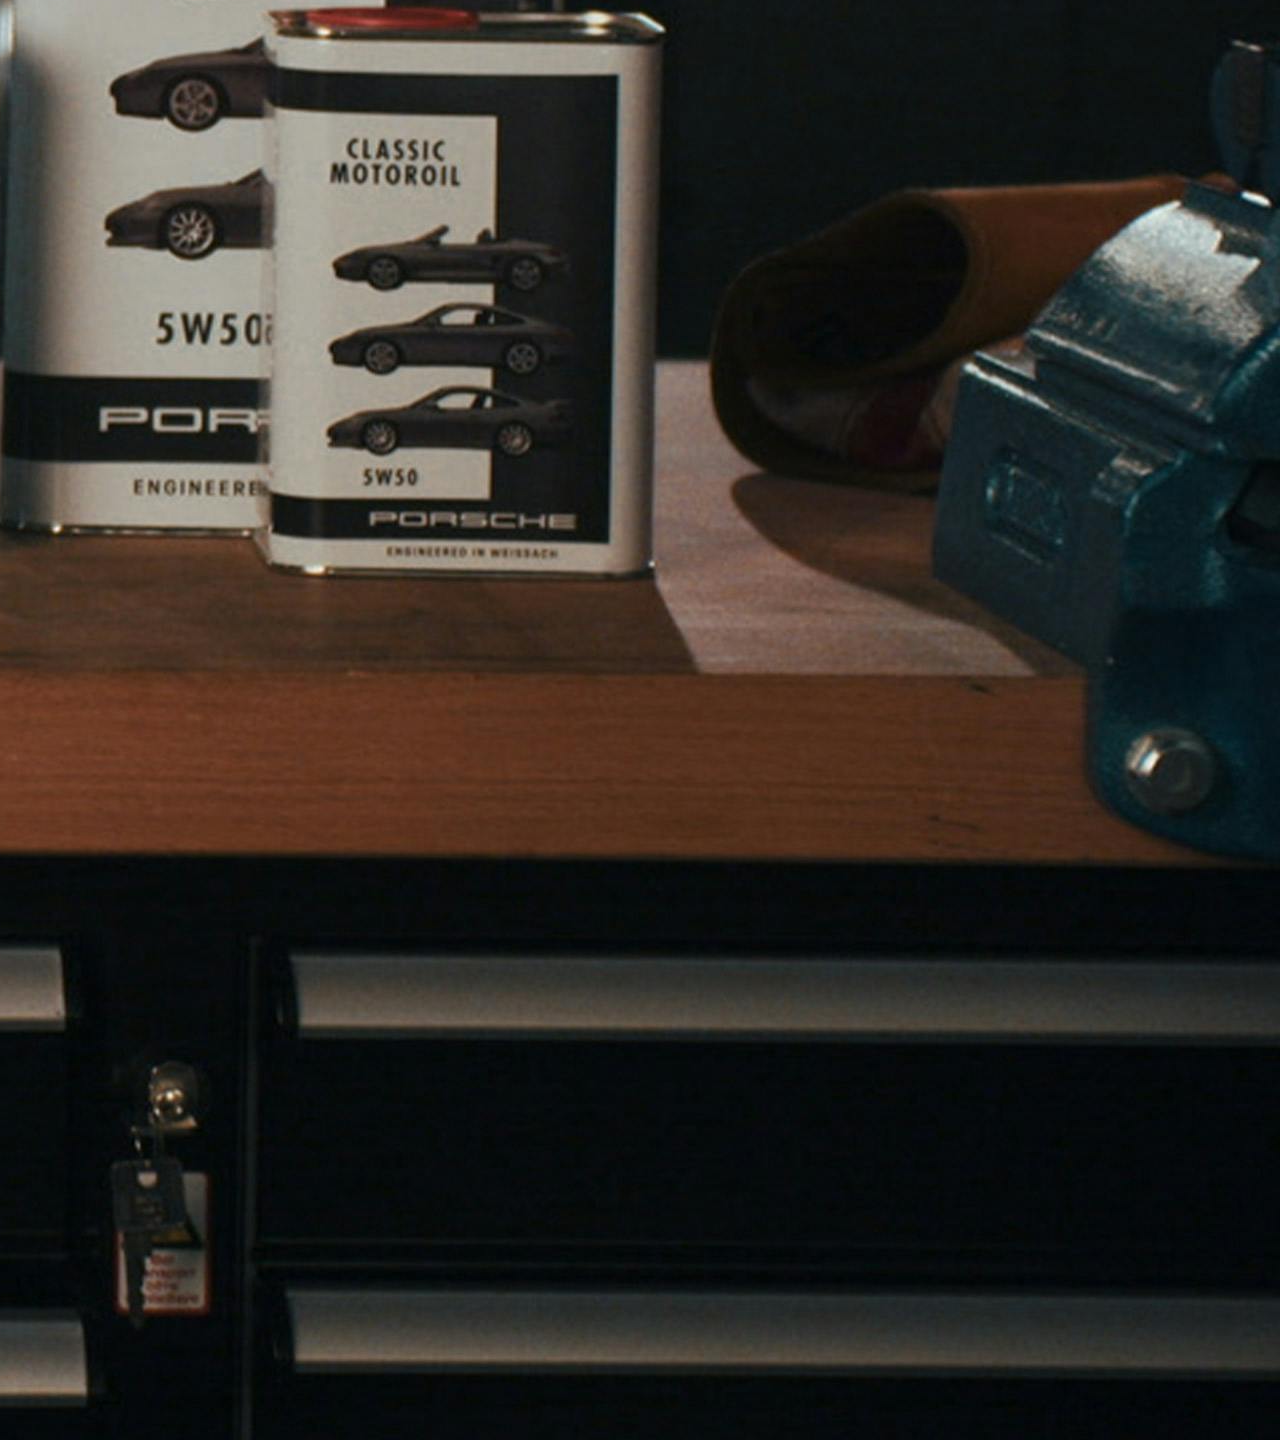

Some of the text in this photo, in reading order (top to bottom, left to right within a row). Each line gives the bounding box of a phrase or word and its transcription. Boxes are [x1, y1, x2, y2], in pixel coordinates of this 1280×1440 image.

[346, 138, 445, 162] CLASSIC
[329, 163, 461, 187] MOTOROIL
[156, 312, 262, 346] 5W50
[98, 406, 258, 433] POR
[362, 468, 419, 487] 5W50
[368, 511, 576, 530] PORSCHE
[386, 545, 559, 559] ENGINEERED IN WEISSACH
